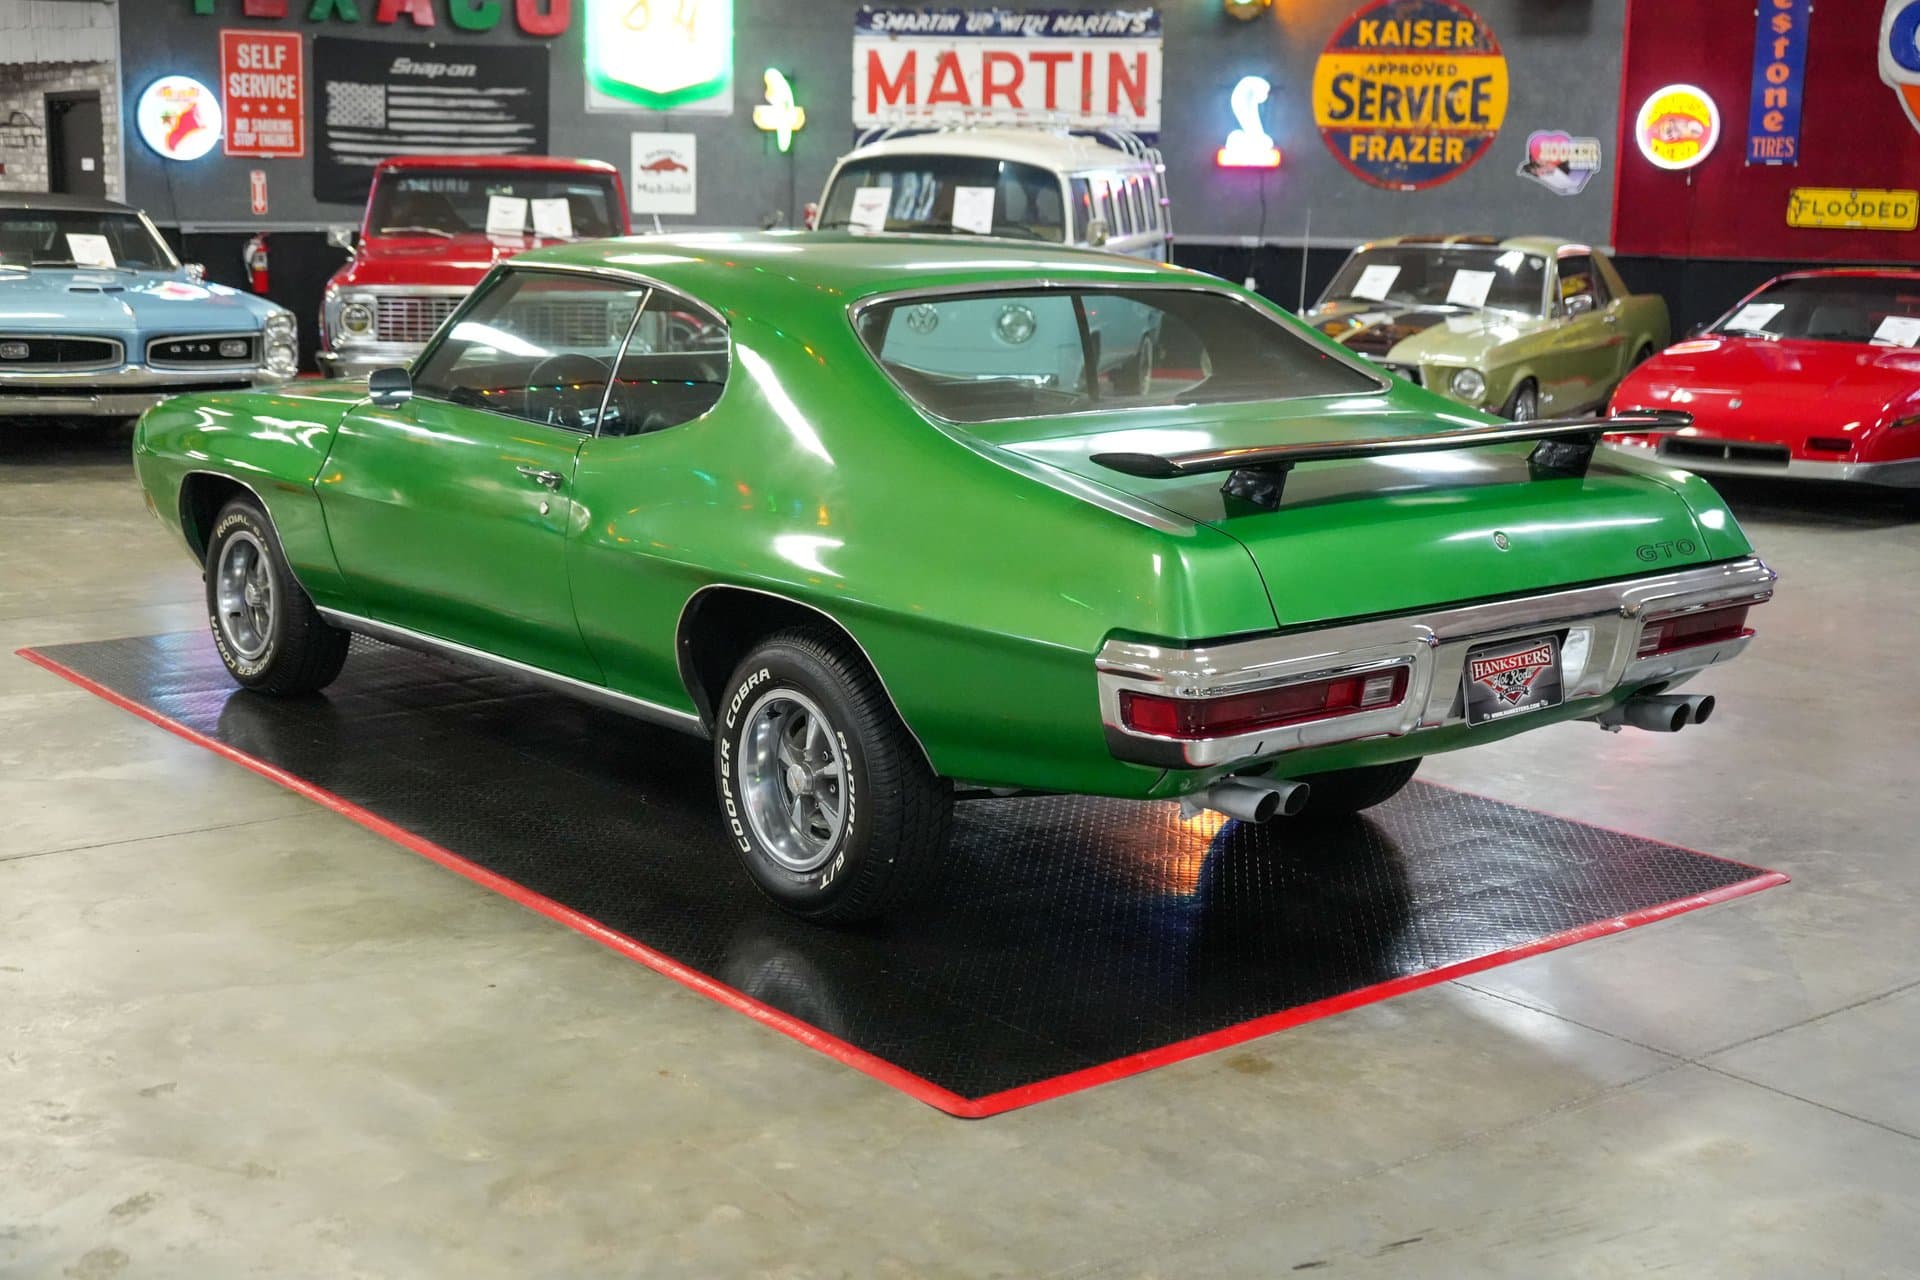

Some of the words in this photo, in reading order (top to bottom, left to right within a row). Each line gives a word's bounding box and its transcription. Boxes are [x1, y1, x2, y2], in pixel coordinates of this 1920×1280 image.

[965, 13, 994, 32] UP
[1357, 19, 1475, 48] KAISER
[237, 43, 287, 70] SELF
[389, 57, 477, 79] Snap-on
[1365, 61, 1458, 77] APPROVED
[229, 72, 297, 99] SERVICE
[867, 49, 1147, 118] MARTIN
[1328, 72, 1492, 125] SERVICE
[1350, 134, 1465, 164] FRAZER
[1752, 136, 1795, 158] TIRES
[1799, 200, 1909, 218] FLOODED
[170, 345, 210, 353] GTO
[216, 514, 250, 538] RADIAL
[1635, 538, 1696, 563] GTO
[1473, 647, 1550, 680] HANKSTERS
[726, 667, 772, 729] COBRA
[721, 738, 751, 853] COOPER
[836, 731, 857, 839] RADIAL
